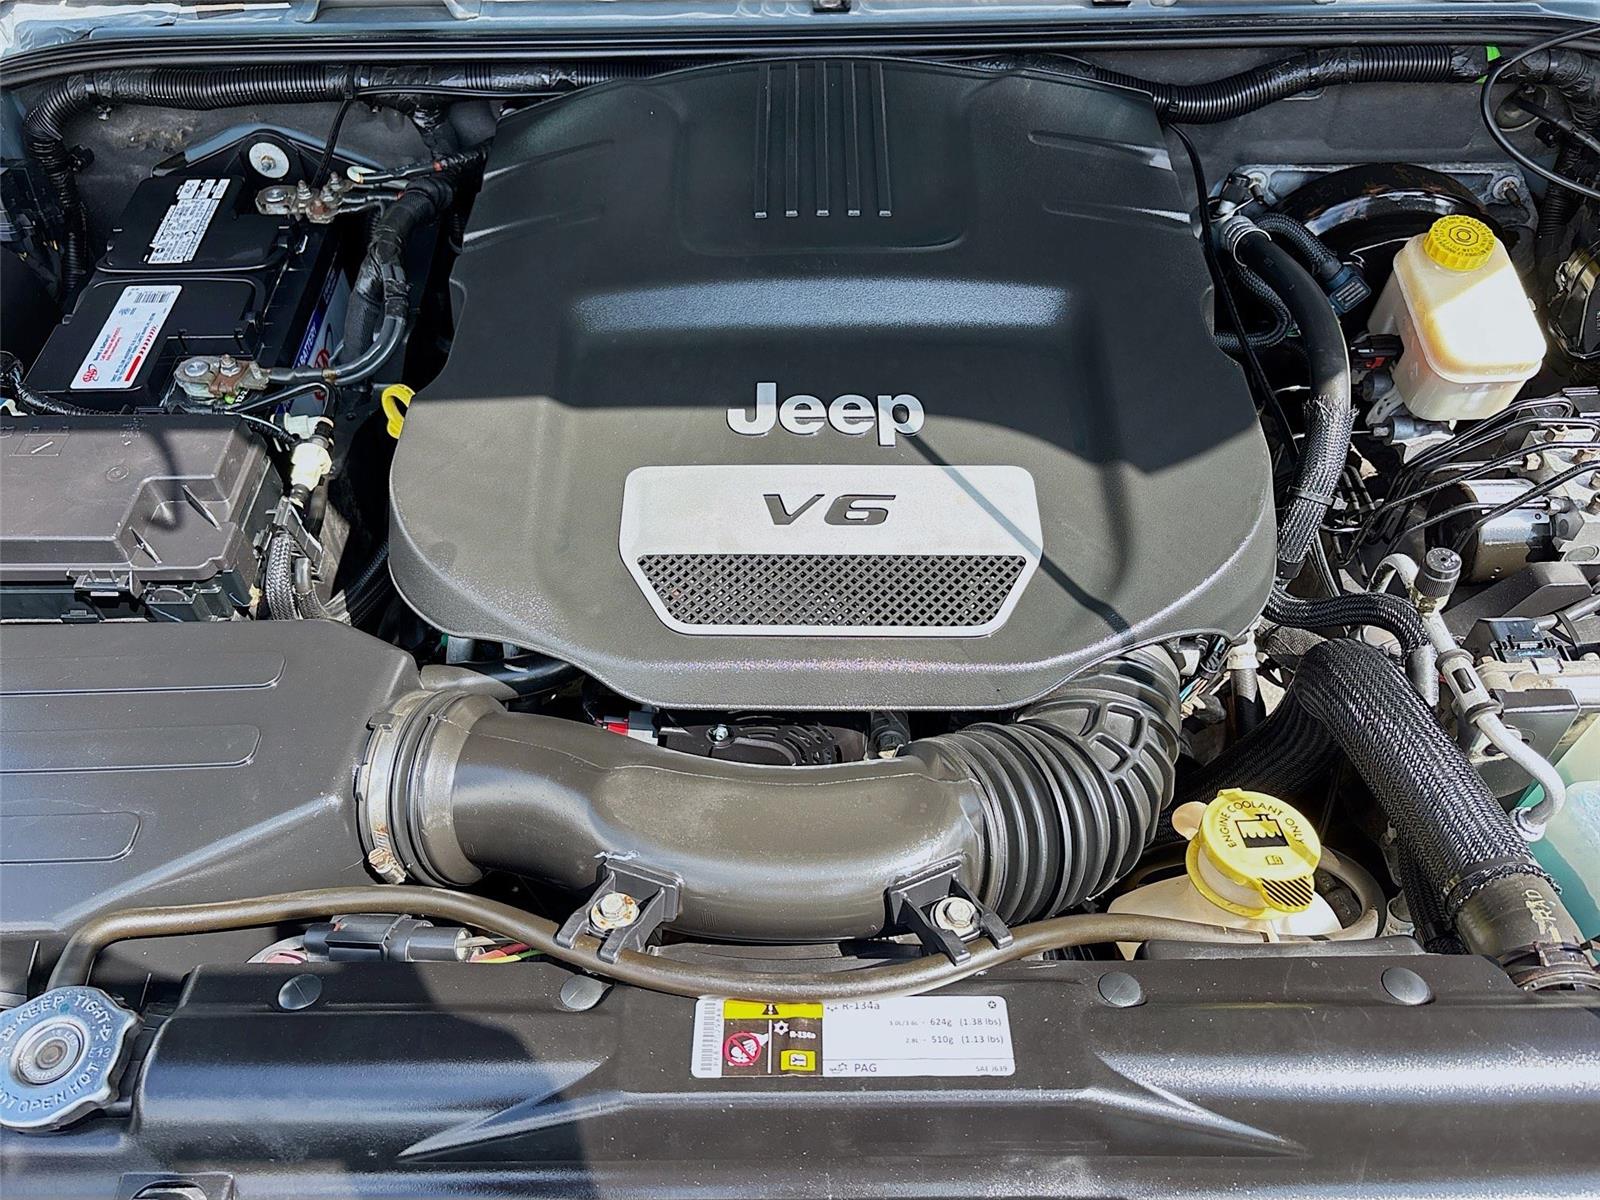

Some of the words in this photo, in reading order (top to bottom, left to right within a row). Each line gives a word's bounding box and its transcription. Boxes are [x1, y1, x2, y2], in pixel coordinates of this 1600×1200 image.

[726, 382, 925, 447] Jeep
[762, 494, 896, 525] V6
[1227, 800, 1283, 816] COOLANT
[1219, 812, 1237, 848] ENGINE
[1285, 817, 1305, 845] ONLY
[16, 995, 65, 1025] KEEP
[75, 994, 111, 1024] TIGHT
[930, 1018, 952, 1027] 624g
[959, 1018, 983, 1027] (1.38
[985, 1018, 1002, 1027] lbs)
[931, 1036, 954, 1045] 510g
[961, 1036, 985, 1045] (1.13
[987, 1036, 1004, 1045] lbs)
[854, 1063, 877, 1073] PAG
[18, 1090, 67, 1113] OPEN
[69, 1062, 99, 1095] HOT
